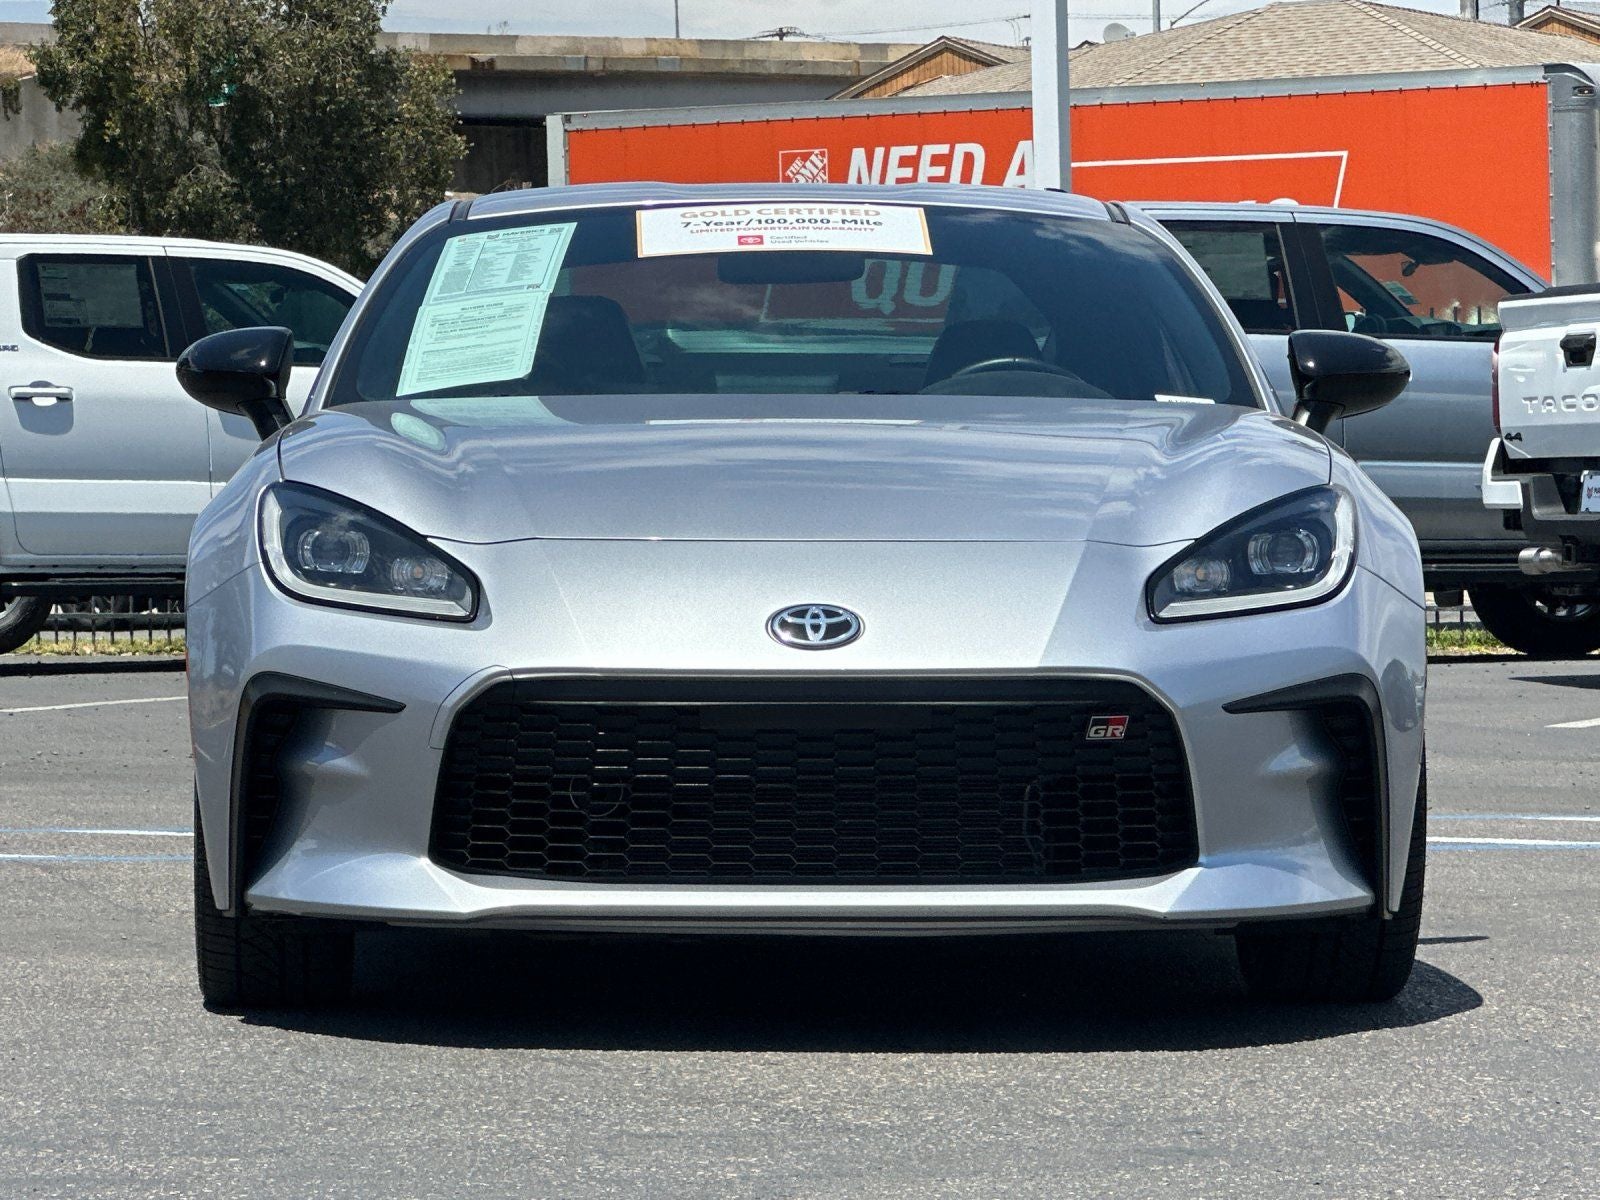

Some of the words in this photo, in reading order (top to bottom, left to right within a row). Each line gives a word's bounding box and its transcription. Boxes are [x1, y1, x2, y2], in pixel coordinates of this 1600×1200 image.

[784, 156, 805, 178] THE
[847, 143, 985, 185] NEED
[1003, 139, 1033, 188] A
[680, 209, 751, 219] GOLD
[756, 207, 881, 217] CERTIFIED
[681, 218, 883, 228] 7-Year/100,000-Mile
[1522, 394, 1600, 414] TACO
[1089, 725, 1124, 738] GR
